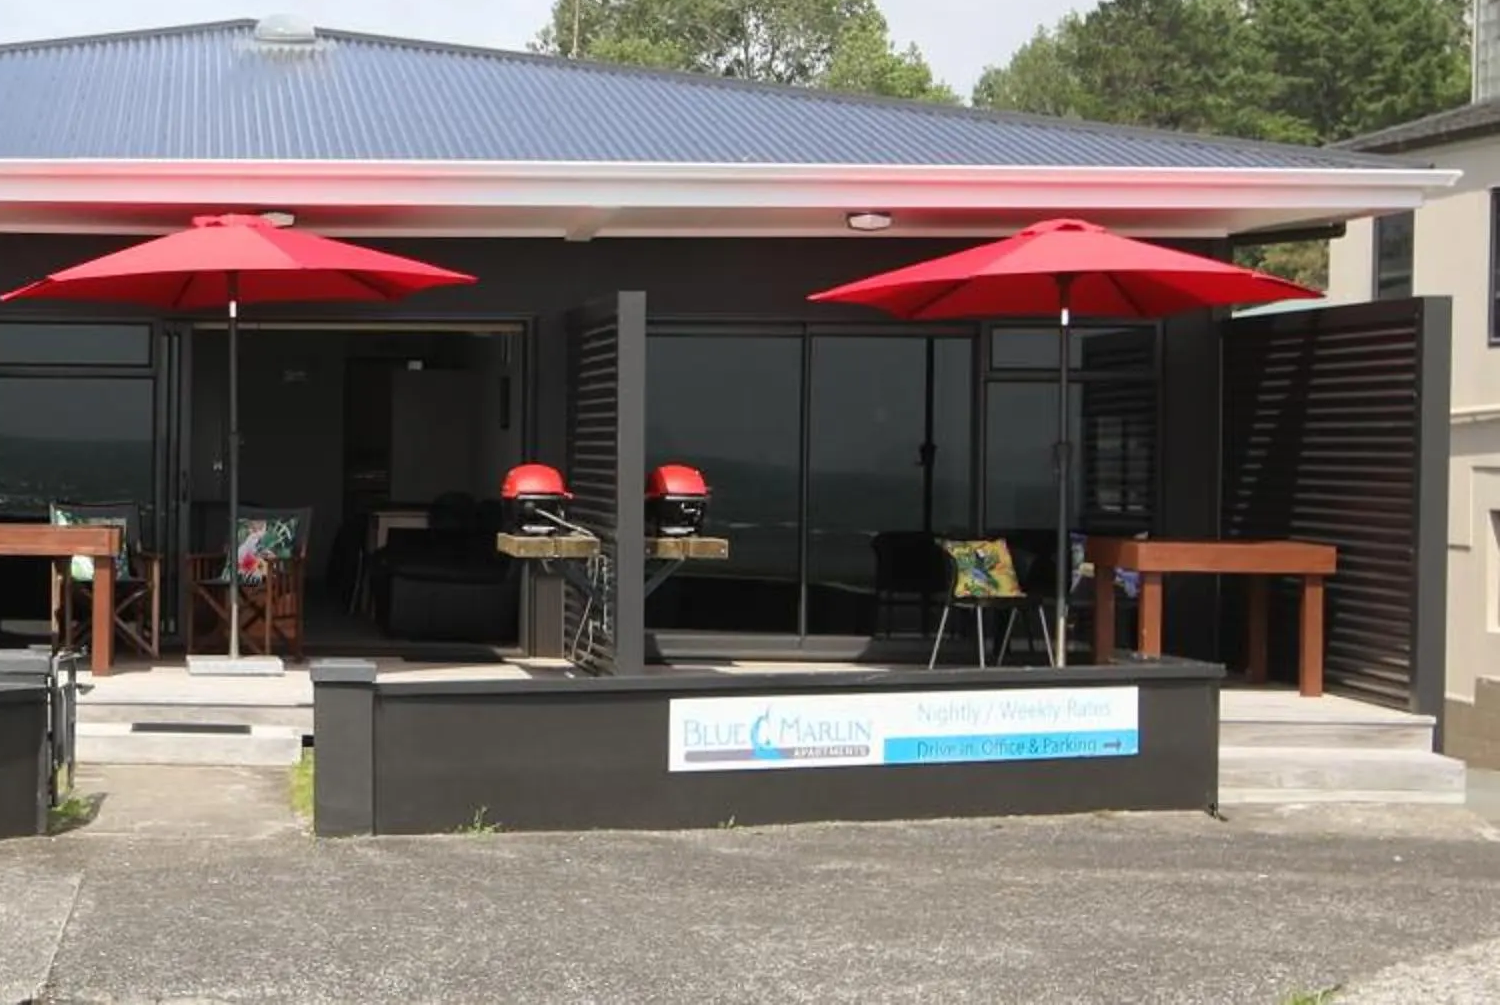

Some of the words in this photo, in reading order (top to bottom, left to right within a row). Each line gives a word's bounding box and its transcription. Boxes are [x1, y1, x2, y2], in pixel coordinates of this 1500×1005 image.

[916, 701, 979, 727] Nightly
[1000, 699, 1062, 723] Weekly
[683, 718, 746, 746] BLUE
[779, 717, 873, 744] MARLIN
[792, 745, 867, 759] APARTMENTS
[1043, 737, 1098, 757] Parking
